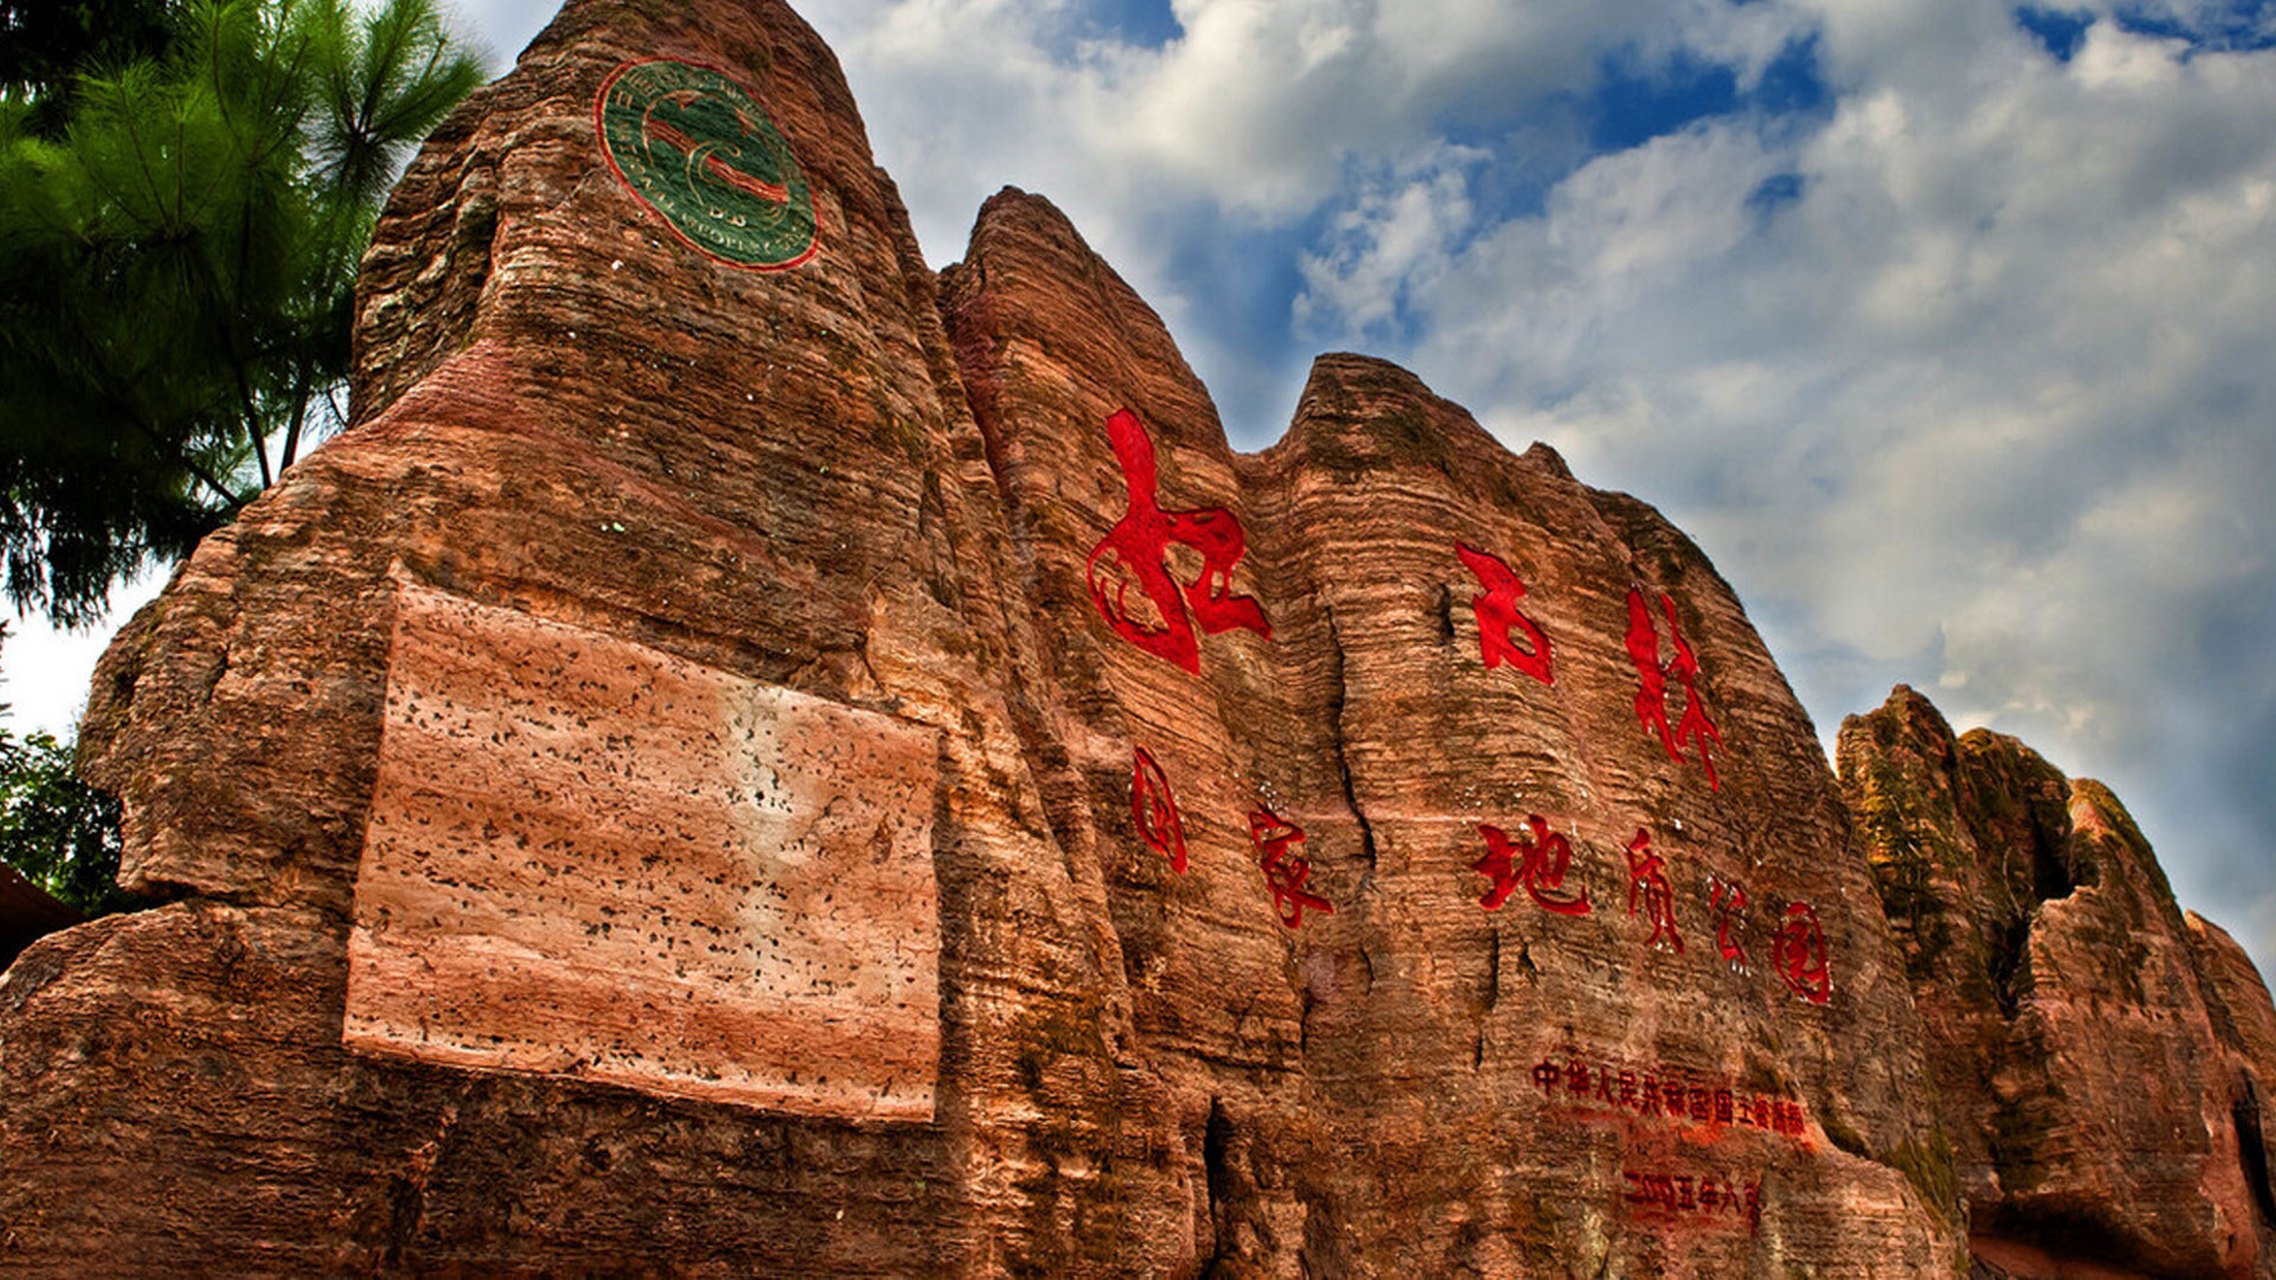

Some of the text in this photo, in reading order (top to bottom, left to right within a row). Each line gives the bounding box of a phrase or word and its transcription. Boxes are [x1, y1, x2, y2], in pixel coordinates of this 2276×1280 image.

[1087, 406, 1727, 793] 红石林
[1133, 746, 1831, 1004] 国家地质公园
